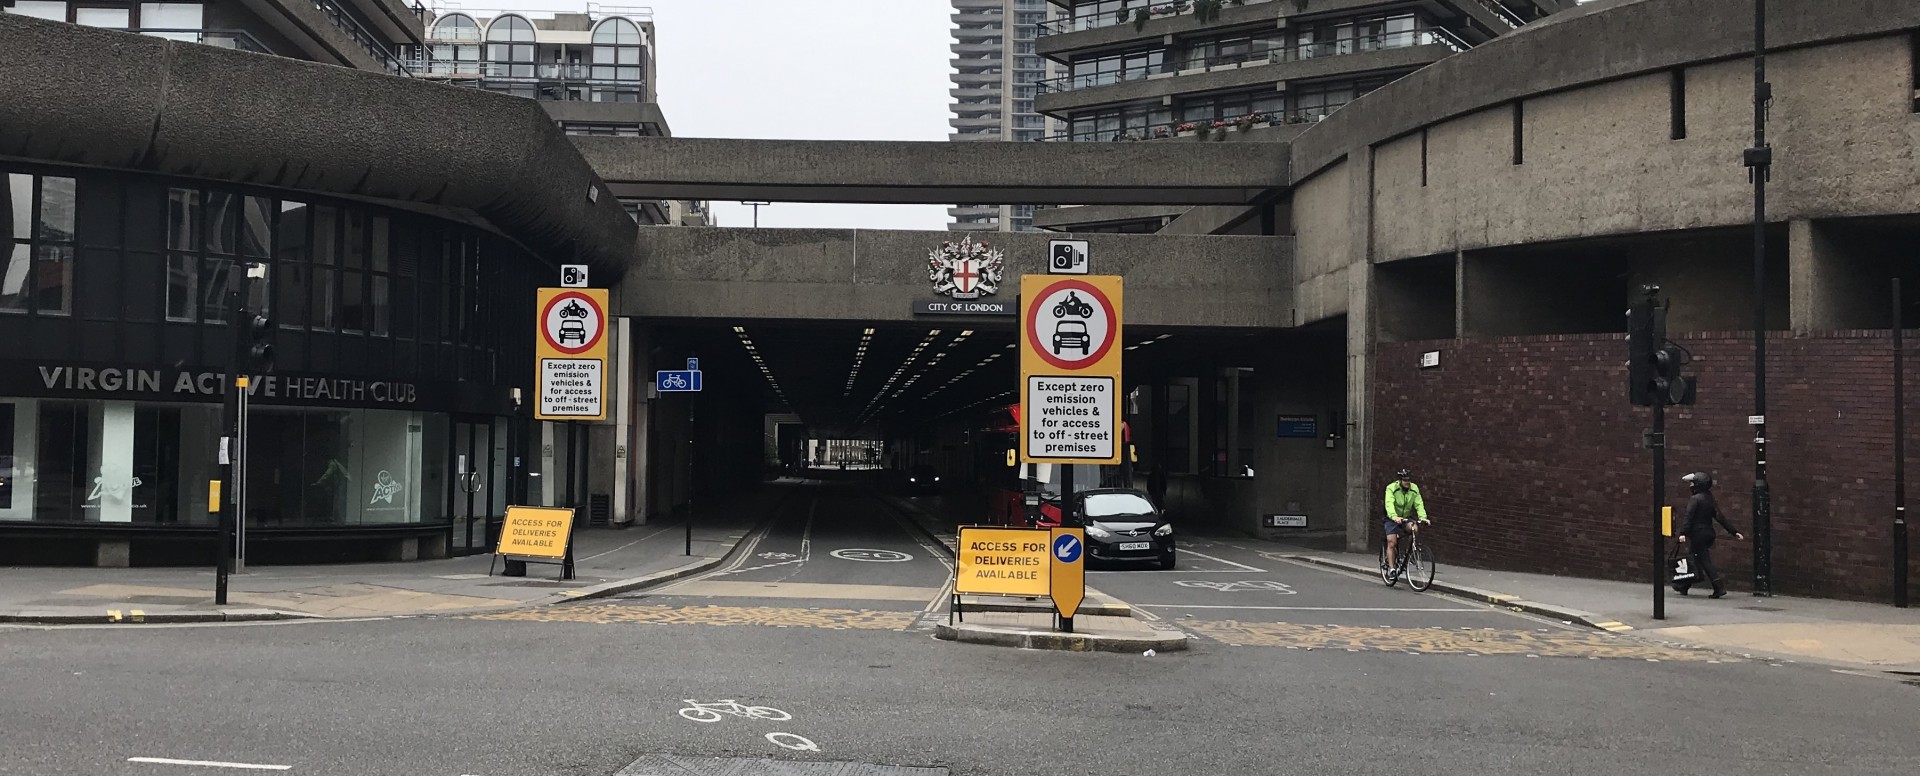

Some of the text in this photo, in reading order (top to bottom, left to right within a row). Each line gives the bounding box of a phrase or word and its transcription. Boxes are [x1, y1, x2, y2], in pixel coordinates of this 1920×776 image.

[928, 303, 1003, 312] CITY OF LONDON
[547, 362, 576, 370] Except
[38, 366, 417, 403] VIRGIN ACTVE HEALTH CLUB
[550, 379, 584, 387] vehicles
[1037, 381, 1105, 393] Except zero
[550, 387, 562, 395] for
[1046, 394, 1096, 404] emission
[552, 404, 589, 412] premises
[1042, 406, 1100, 416] vehicles &
[1041, 417, 1100, 428] for access
[1033, 429, 1045, 439] to
[1045, 442, 1097, 453] premises
[511, 518, 563, 528] ACCESS FOR
[512, 528, 557, 538] DELIVERIES
[511, 538, 554, 548] AVAILABLE
[970, 541, 1046, 553] ACCESS FOR
[975, 555, 1040, 566] DELIVERIES
[976, 569, 1038, 580] AVAILABLE
